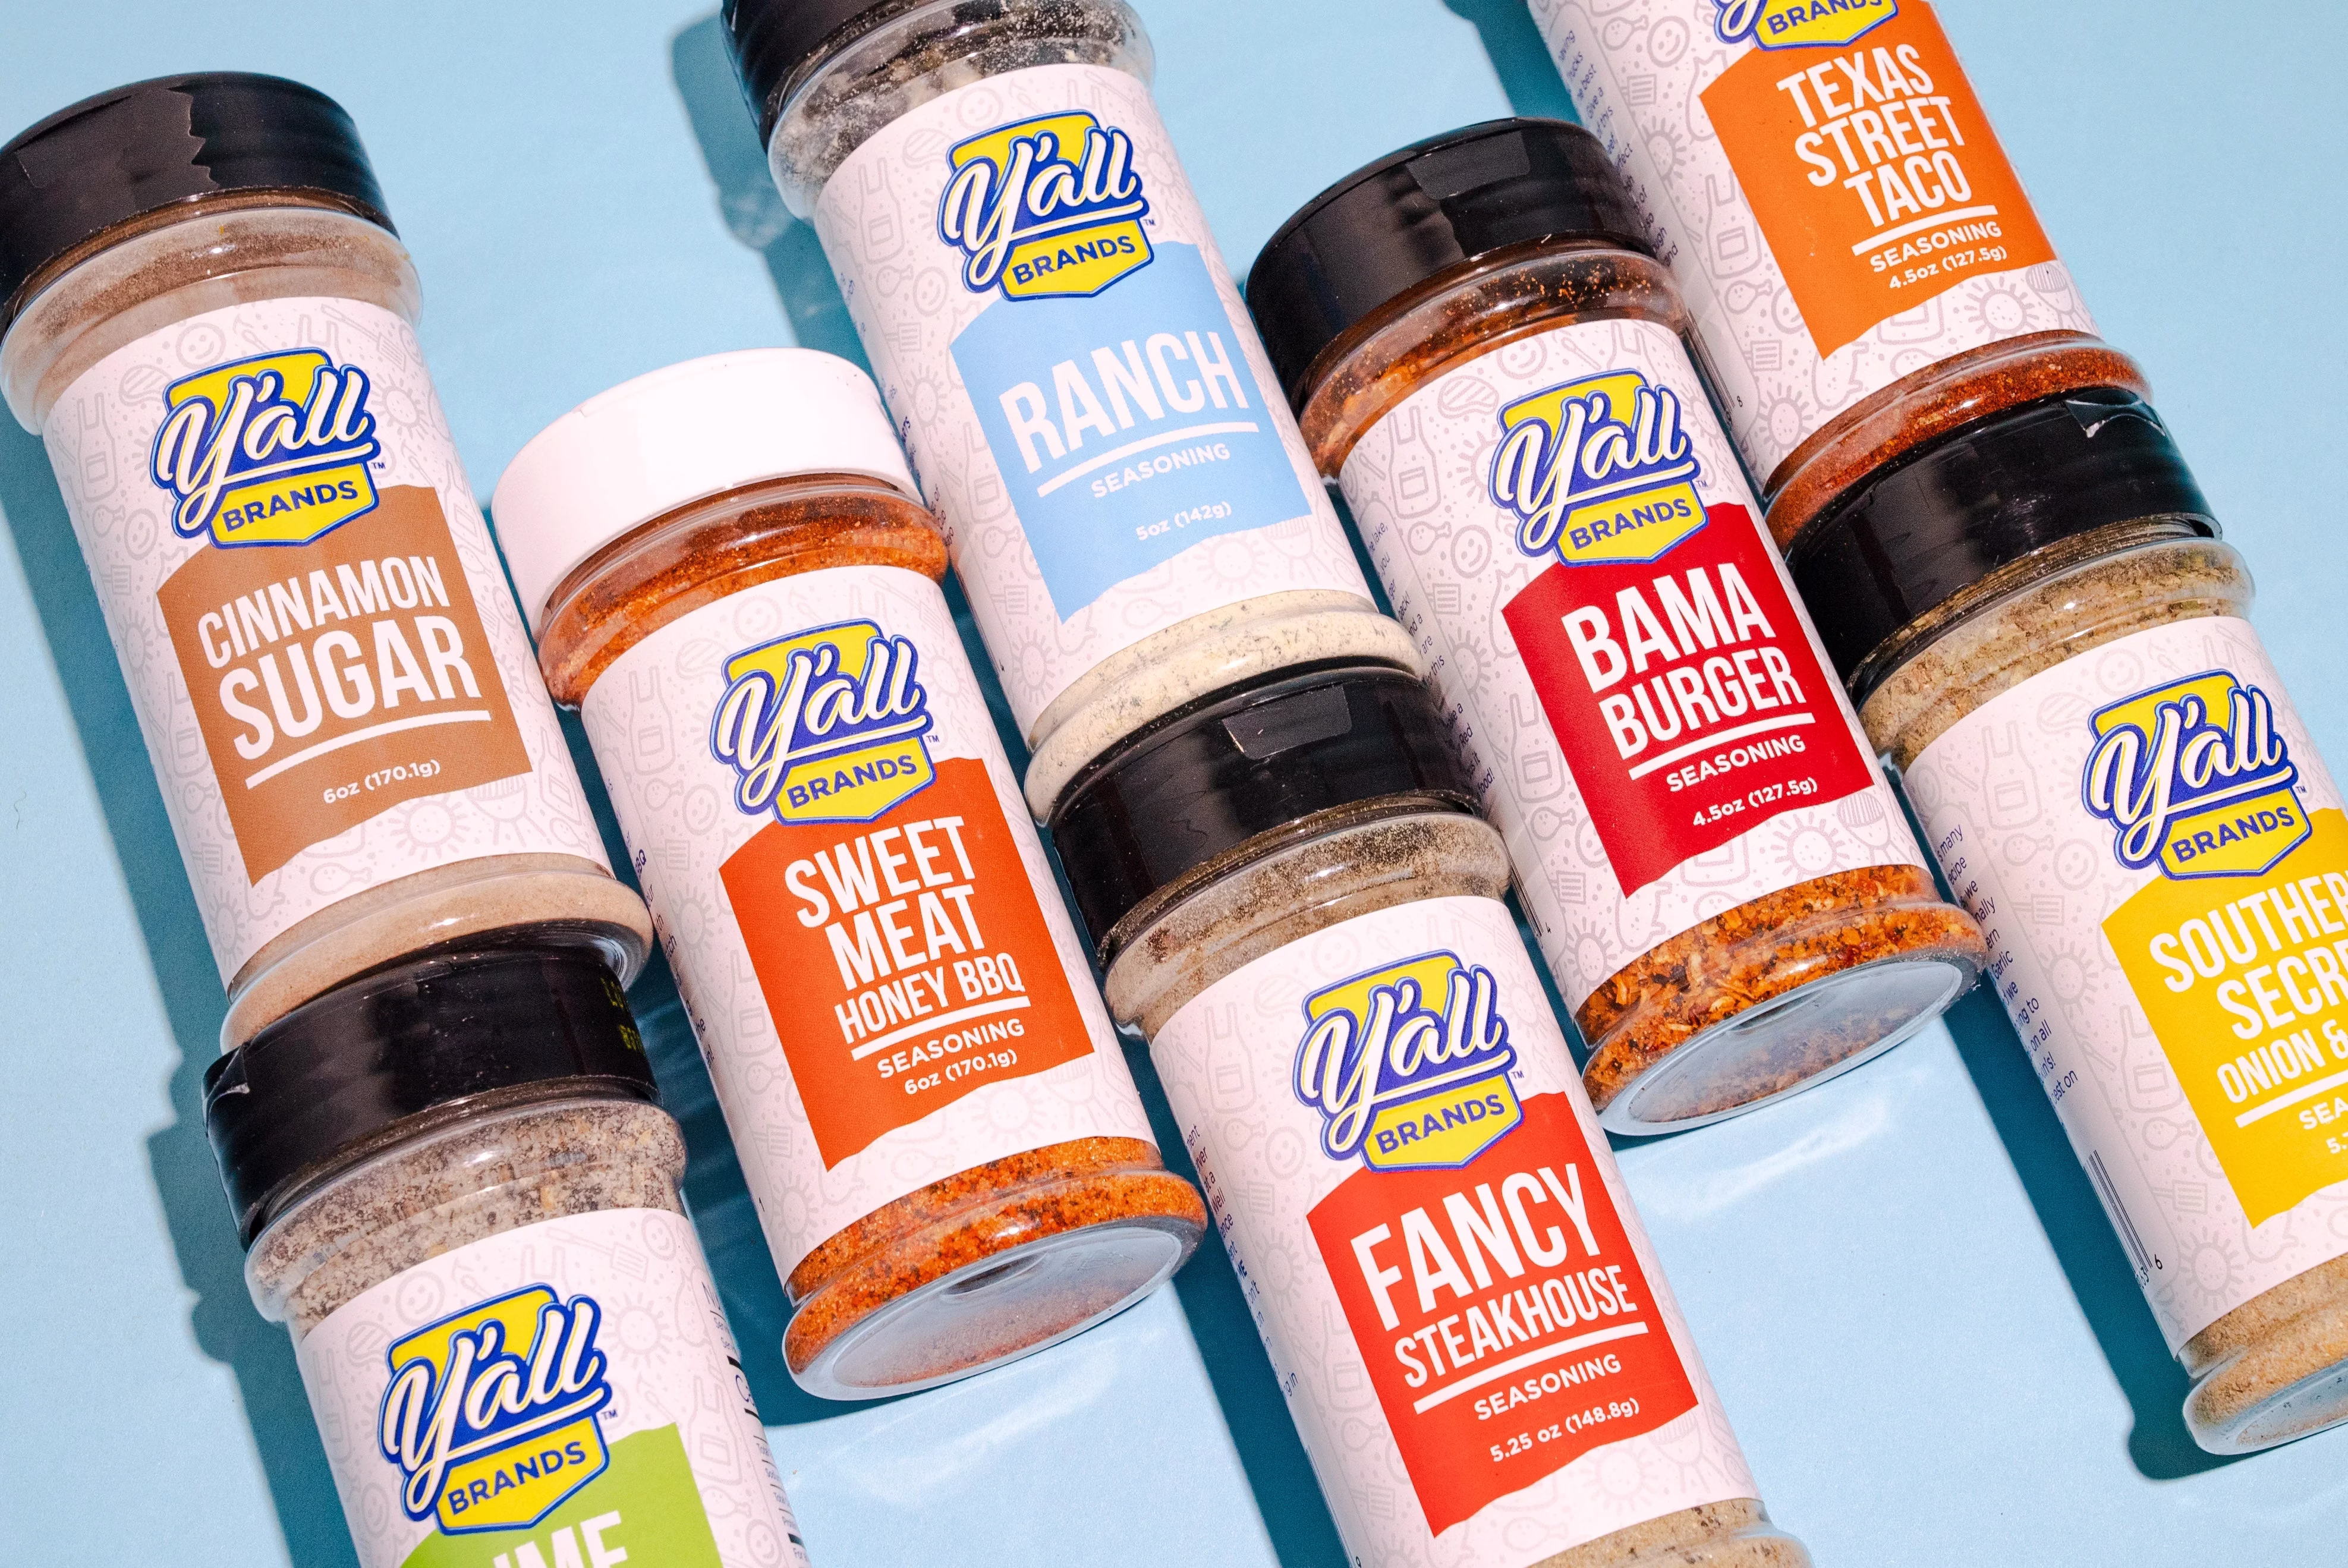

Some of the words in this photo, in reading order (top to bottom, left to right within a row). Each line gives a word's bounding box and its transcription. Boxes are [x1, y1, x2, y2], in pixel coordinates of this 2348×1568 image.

[1776, 43, 1934, 128] TEXAS
[1794, 96, 1965, 187] STREET
[943, 131, 1144, 286] Y'all
[1843, 150, 1972, 228] TACO
[1012, 235, 1135, 285] BRANDS
[1869, 221, 2002, 273] SEASONING
[1889, 262, 1940, 289] 4.5oz
[1941, 245, 2007, 274] (127.5g)
[999, 331, 1249, 474] RANCH
[156, 366, 373, 527] Y'all
[1091, 443, 1230, 499] SEASONING
[1496, 390, 1695, 550] Y'all
[223, 480, 358, 533] BRANDS
[1136, 518, 1170, 541] 5oz
[1174, 501, 1232, 528] (142g)
[1373, 522, 1388, 546] lake,
[1569, 498, 1692, 550] BRANDS
[197, 556, 451, 669] CINNAMON
[1561, 562, 1776, 694] BAMA
[1422, 635, 1433, 655] are
[1431, 655, 1445, 676] this
[219, 616, 481, 760] SUGAR
[1458, 703, 1463, 714] a
[1598, 646, 1806, 760] BURGER
[716, 637, 926, 805] Y'all
[1459, 723, 1473, 748] Red
[323, 780, 360, 804] 6oz
[364, 759, 440, 791] (170.1g)
[788, 754, 917, 809] BRANDS
[1666, 735, 1806, 792] SEASONING
[2090, 691, 2292, 862] Y'all
[1693, 796, 1746, 827] 4.5oz
[1748, 776, 1818, 809] (127.5g)
[1940, 824, 1963, 856] many
[2171, 806, 2296, 863] BRANDS
[785, 816, 975, 928] SWEET
[1948, 857, 1967, 886] ecipe
[1965, 880, 1978, 900] we
[824, 884, 985, 990] MEAT
[1974, 896, 1996, 925] nally
[1991, 950, 2013, 980] Garlic
[2007, 981, 2018, 1001] we
[834, 966, 948, 1044] HONEY
[953, 952, 1026, 1001] BBQ
[2026, 997, 2039, 1014] to
[877, 1019, 1025, 1078] SEASONING
[1300, 970, 1512, 1153] Y'all
[2029, 1034, 2041, 1051] on
[2039, 1019, 2052, 1041] all
[904, 1073, 941, 1095] 6oz
[945, 1049, 1018, 1082] (170.1g)
[2063, 1069, 2078, 1088] on
[2217, 1028, 2326, 1104] ONION
[1375, 1094, 1505, 1155] BRANDS
[2299, 1097, 2348, 1130] SEA
[1209, 1171, 1216, 1184] a
[1211, 1186, 1226, 1214] Well
[1351, 1163, 1601, 1331] FANCY
[2154, 1254, 2163, 1270] 6
[1395, 1265, 1638, 1388] STEAKHOUSE
[383, 1302, 605, 1514] Y'all
[1474, 1353, 1622, 1420] SEASONING
[1490, 1436, 1533, 1462] 5.25
[1537, 1424, 1562, 1442] oz
[1565, 1397, 1640, 1434] (148.8g)
[447, 1440, 586, 1515] BRANDS
